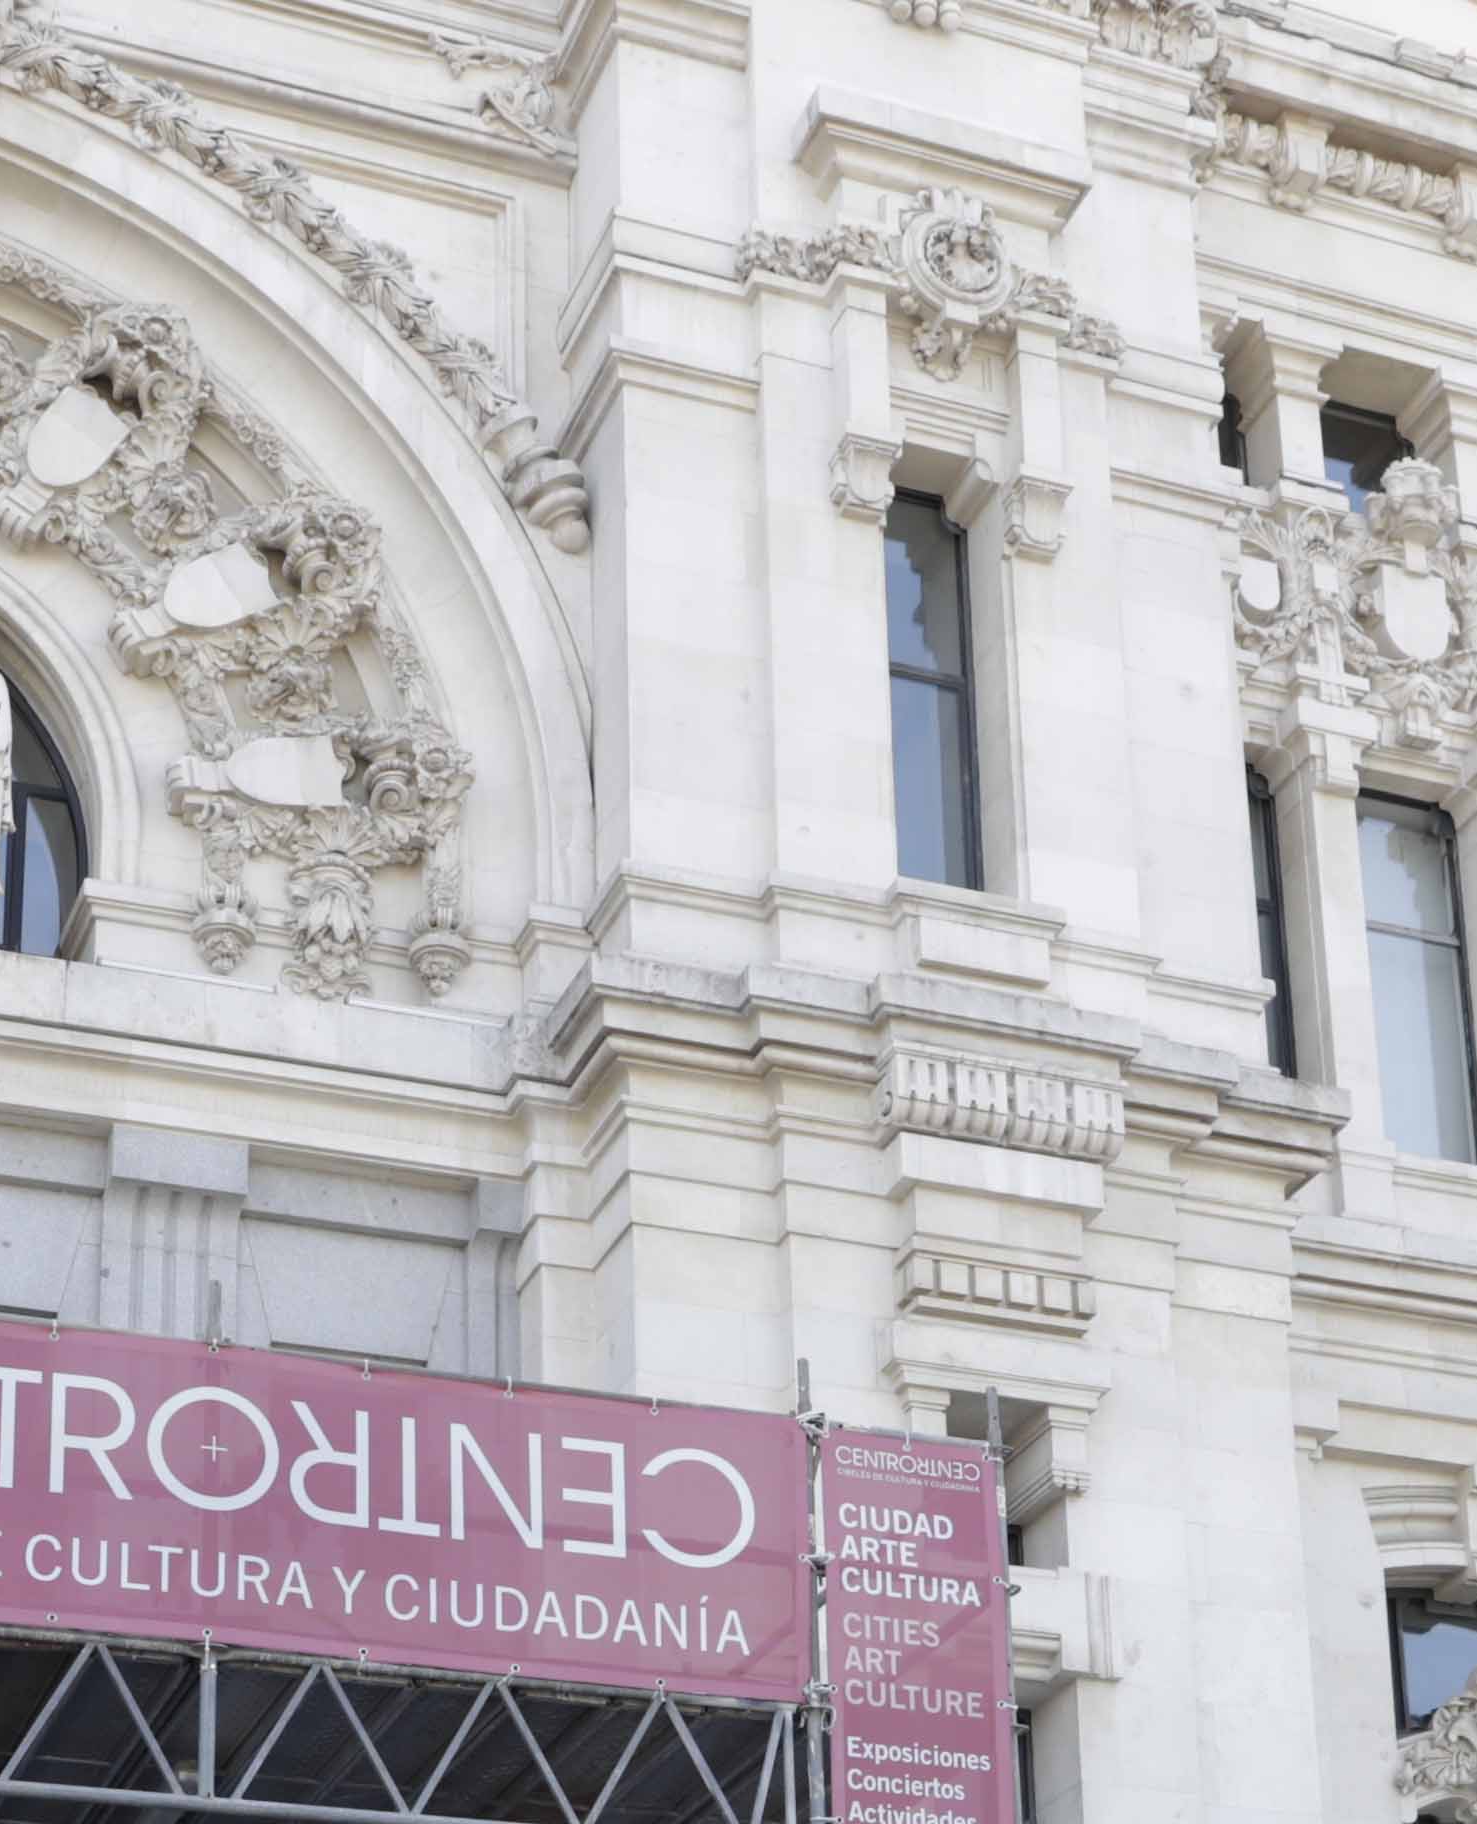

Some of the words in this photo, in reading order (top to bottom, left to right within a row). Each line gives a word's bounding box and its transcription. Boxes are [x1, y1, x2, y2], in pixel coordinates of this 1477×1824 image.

[839, 1503, 953, 1540] CIUDAD
[841, 1535, 919, 1568] ARTE
[25, 1534, 313, 1609] CULTURA
[332, 1566, 366, 1615] Y
[384, 1573, 750, 1656] CIUDADANÍA
[841, 1567, 981, 1607] CULTURA
[843, 1612, 940, 1648] CITIES
[844, 1645, 902, 1675] ART
[844, 1678, 985, 1718] CULTURE
[847, 1736, 991, 1771] Exposiciones
[847, 1768, 965, 1800] Conciertos
